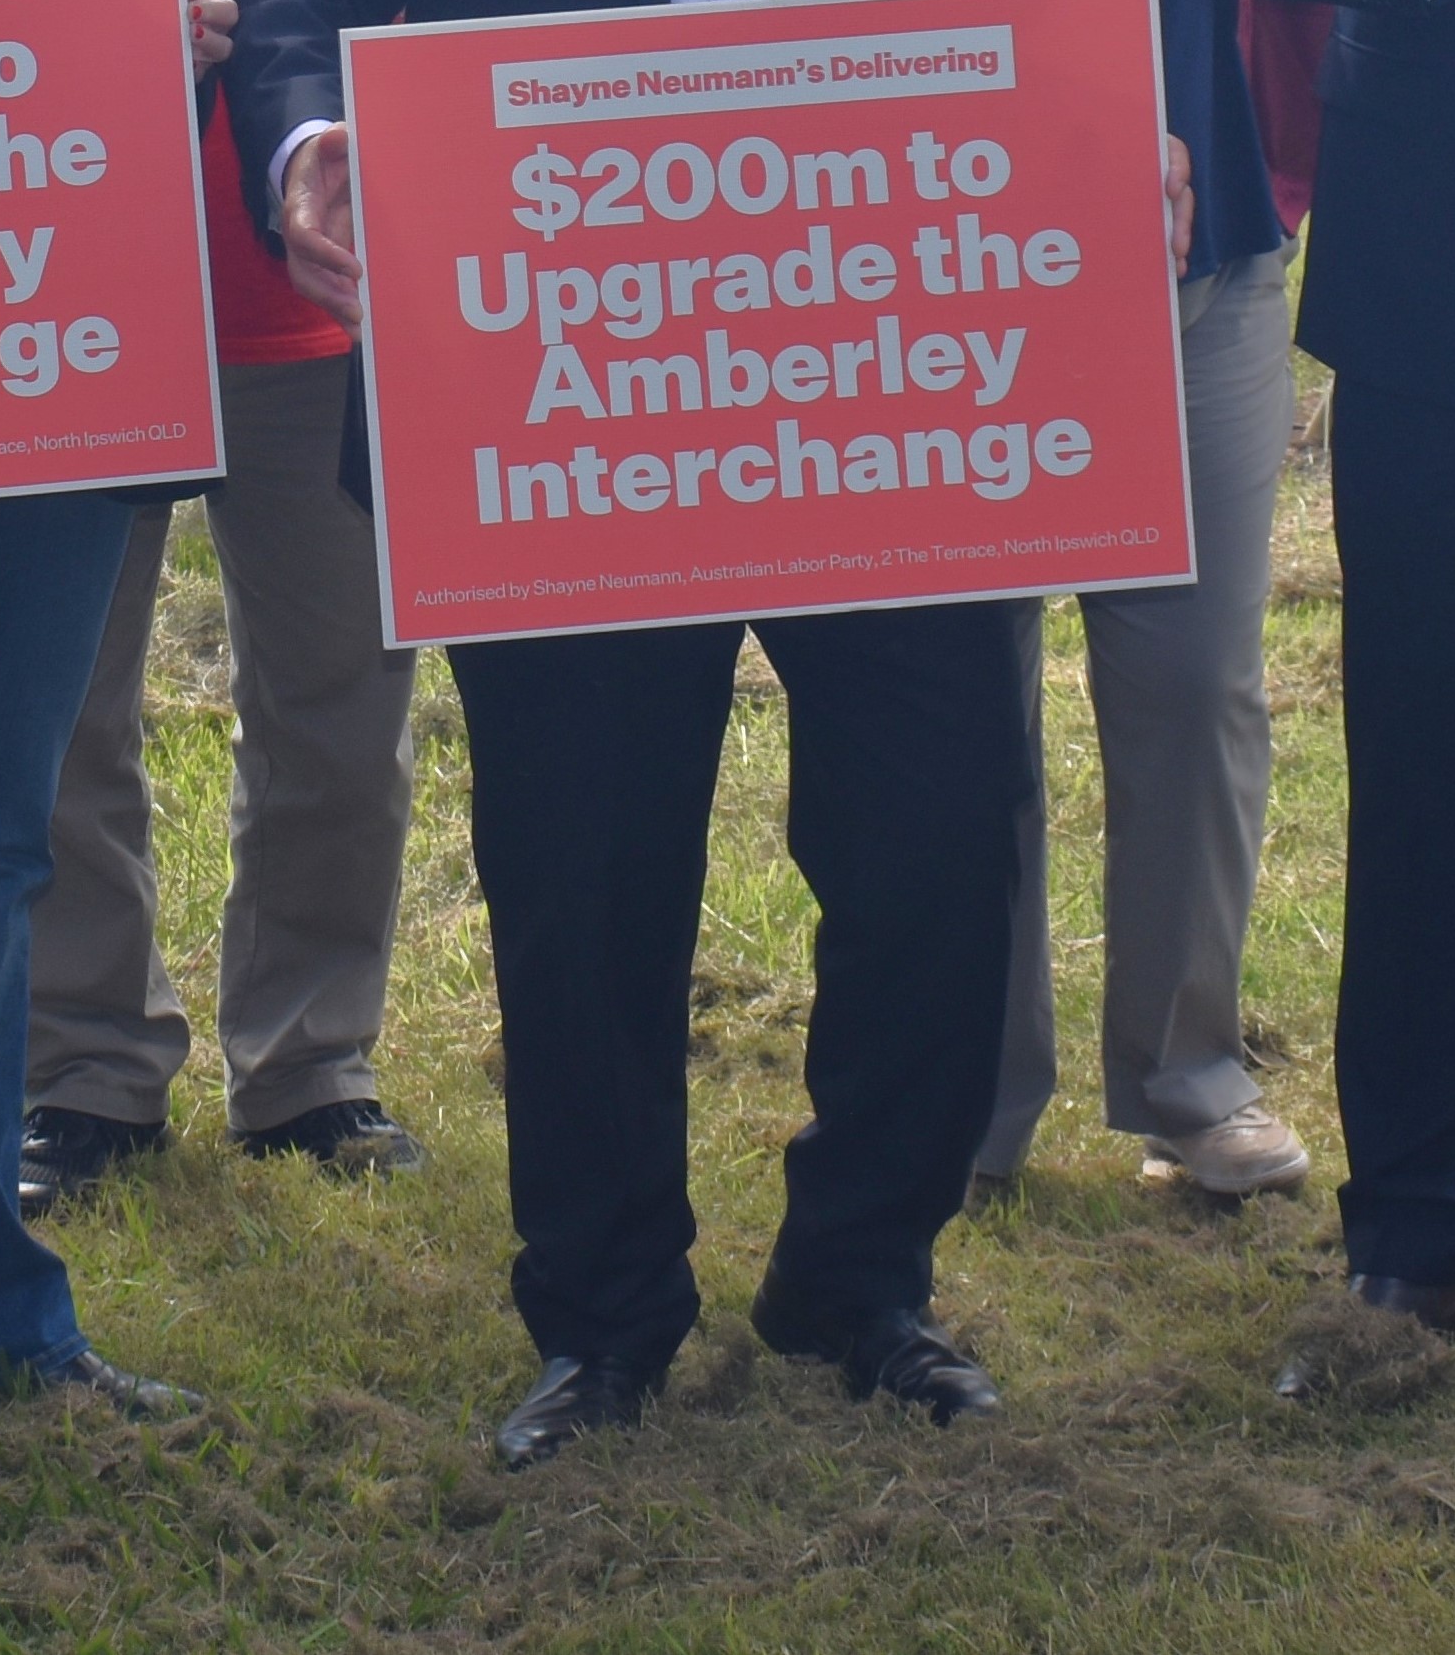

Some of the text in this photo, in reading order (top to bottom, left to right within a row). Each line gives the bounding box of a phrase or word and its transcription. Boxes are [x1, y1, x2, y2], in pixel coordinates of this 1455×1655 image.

[507, 79, 630, 107] Shayne
[831, 48, 999, 82] Delivering
[512, 131, 1012, 242] $200m to
[456, 213, 1081, 345] Upgrade the
[525, 316, 1028, 426] Amberley
[34, 432, 81, 451] North
[84, 426, 146, 448] Ipswich
[148, 422, 187, 441] QLD
[474, 418, 1093, 524] Interchange
[414, 527, 1160, 607] Authorised by Shayne Neumann, Australian Labor Party, 2 The Terrace, North Ipswich QLD
